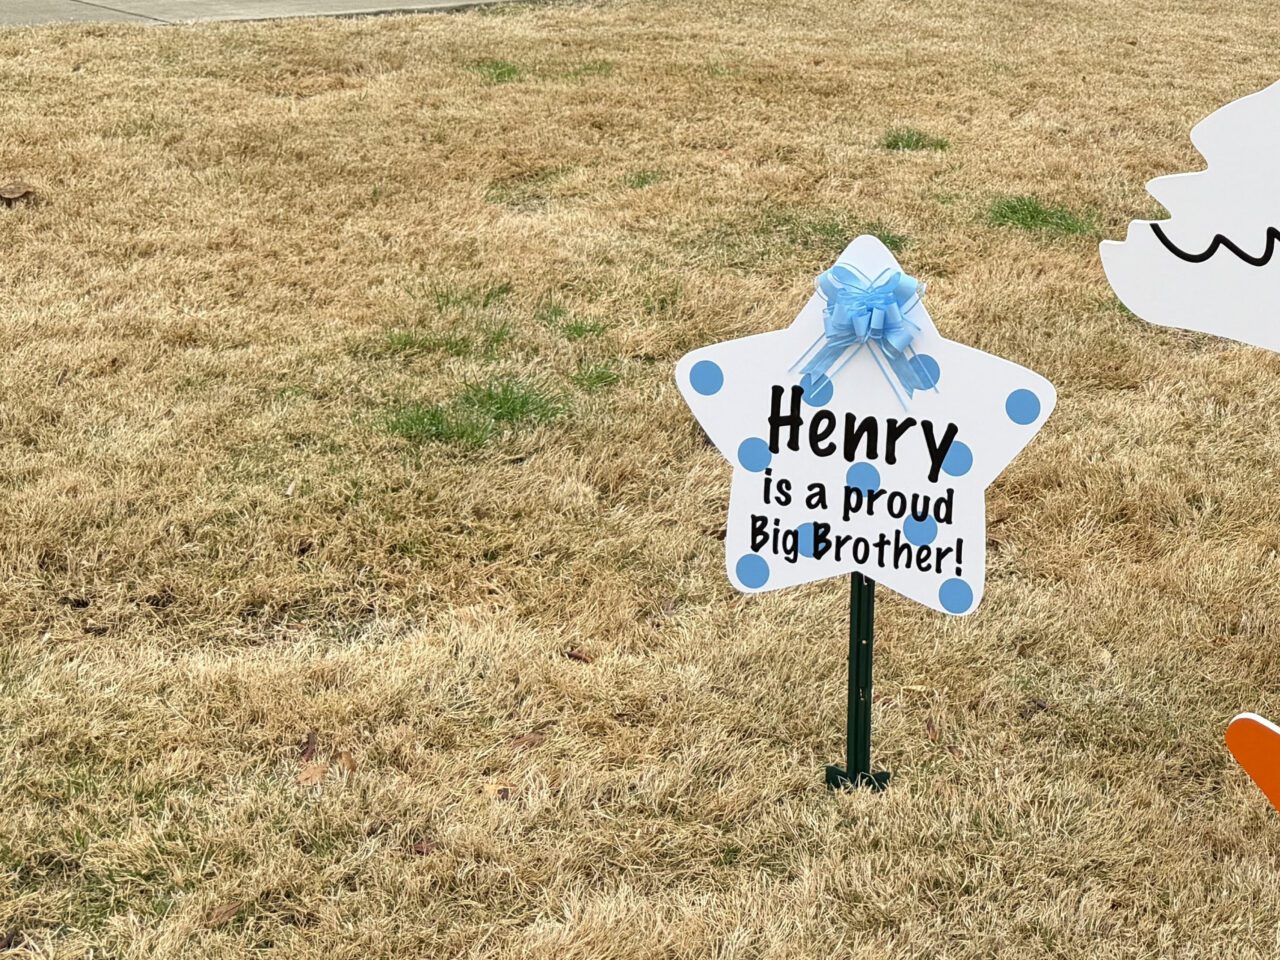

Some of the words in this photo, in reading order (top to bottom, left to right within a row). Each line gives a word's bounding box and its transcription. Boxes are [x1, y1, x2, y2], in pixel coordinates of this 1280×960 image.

[767, 384, 959, 483] Henry
[763, 467, 792, 507] is
[805, 482, 828, 510] a
[842, 485, 955, 525] proud
[750, 514, 799, 564] Big
[812, 521, 964, 577] Brother!
